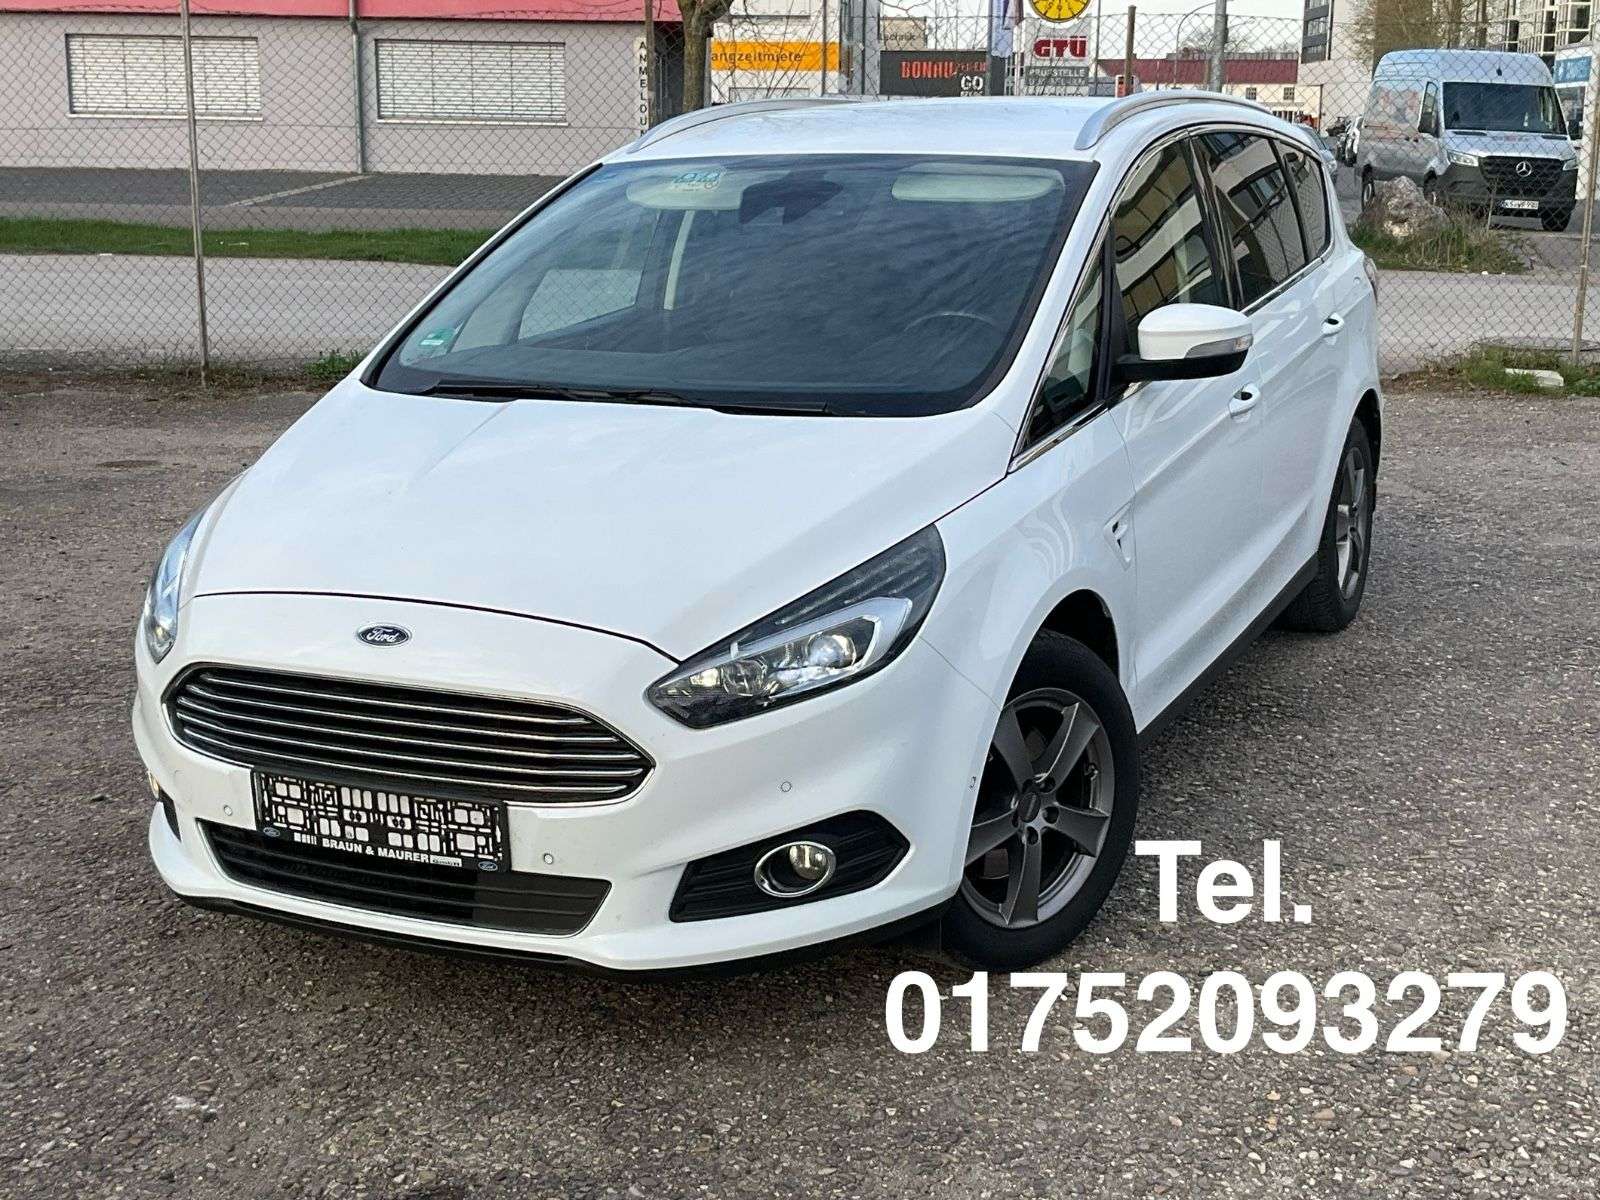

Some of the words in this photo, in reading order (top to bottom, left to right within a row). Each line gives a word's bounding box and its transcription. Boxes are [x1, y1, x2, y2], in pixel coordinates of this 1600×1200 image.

[1033, 35, 1086, 58] GTÜ
[960, 75, 984, 91] GO
[366, 627, 400, 643] Ford
[322, 837, 363, 854] BRAUN
[365, 845, 375, 856] &
[377, 846, 430, 864] MAURER
